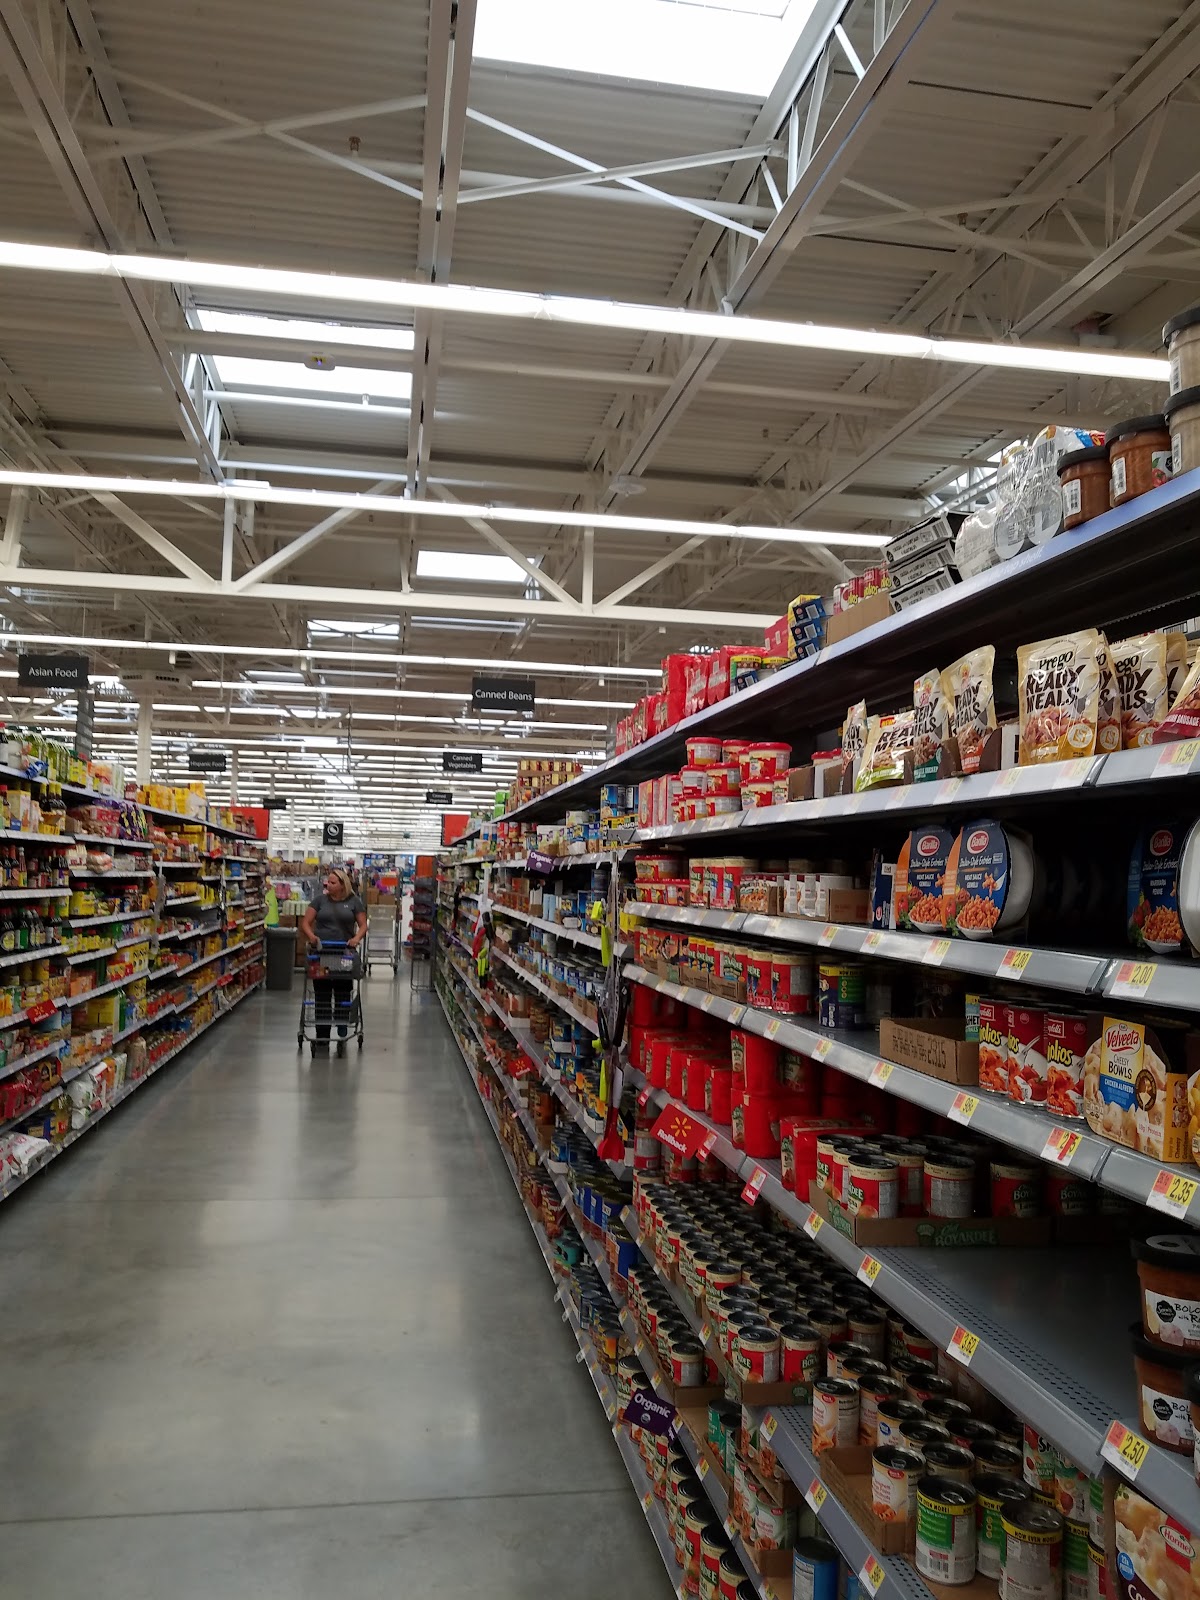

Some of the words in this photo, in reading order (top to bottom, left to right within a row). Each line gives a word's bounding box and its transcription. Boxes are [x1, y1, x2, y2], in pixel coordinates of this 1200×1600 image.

[1039, 649, 1073, 672] Prego
[28, 666, 53, 678] Asian
[55, 667, 78, 679] Food
[1026, 664, 1086, 697] READY
[475, 688, 507, 700] Canned
[508, 690, 533, 701] Beans
[1026, 686, 1080, 714] MEALS
[190, 760, 209, 769] Hispanic
[447, 758, 477, 769] Vegetables
[452, 754, 473, 762] Canned
[921, 838, 938, 851] Barilla
[970, 835, 987, 849] Barilla
[530, 851, 553, 864] Organic
[1106, 1029, 1140, 1050] Velveeta
[1113, 1054, 1130, 1066] CHEESY
[1108, 1062, 1133, 1080] BOWLS
[656, 1128, 688, 1153] Rollback
[634, 1392, 672, 1419] Organic
[1015, 1531, 1027, 1540] NOW
[1164, 1529, 1192, 1554] Hormel
